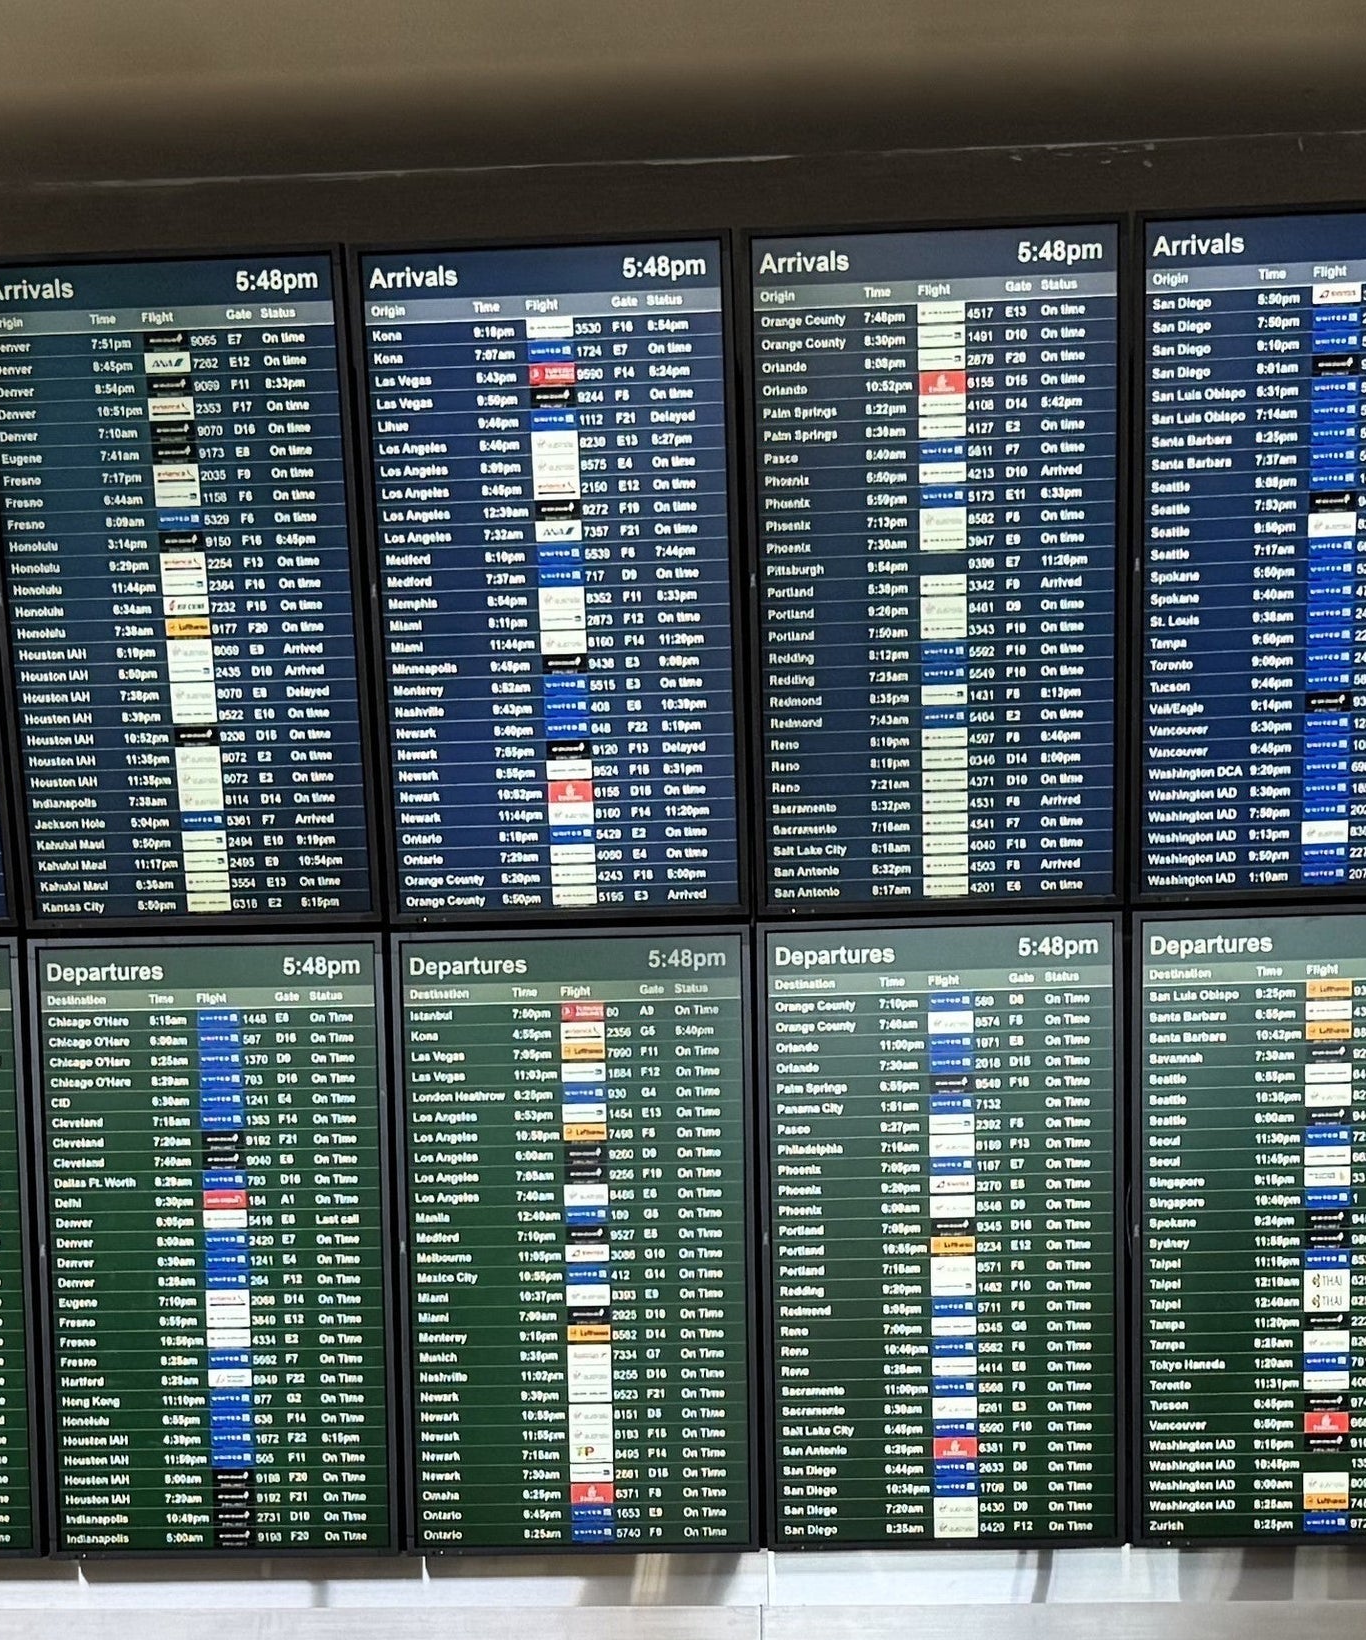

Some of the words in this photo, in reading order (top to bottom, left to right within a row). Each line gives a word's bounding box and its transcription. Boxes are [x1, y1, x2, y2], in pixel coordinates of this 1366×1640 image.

[1017, 239, 1103, 265] 5:48pm
[1152, 232, 1245, 257] Arrivals
[622, 255, 706, 281] 5:48pm
[759, 249, 850, 274] Arrivals
[236, 268, 318, 294] 5:48pm
[369, 264, 458, 289] Arrivals
[1151, 270, 1190, 289] Origin
[1257, 268, 1287, 281] Time
[1313, 264, 1347, 279] Flight
[759, 290, 796, 304] Origin
[863, 286, 892, 299] Time
[917, 283, 951, 298] Flight
[1004, 280, 1033, 292] Gate
[1040, 278, 1078, 291] Status
[88, 313, 117, 325] Time
[141, 311, 174, 326] Flight
[225, 308, 253, 320] Gate
[260, 307, 296, 319] Status
[370, 304, 406, 319] Origin
[472, 301, 501, 313] Time
[525, 298, 558, 313] Flight
[611, 295, 639, 308] Gate
[646, 294, 683, 306] Status
[775, 945, 895, 970] Departures
[1018, 935, 1099, 959] 5:48pm
[1150, 934, 1273, 959] Departures
[283, 956, 361, 979] 5:48pm
[409, 956, 528, 980] Departures
[648, 948, 726, 972] 5:48pm
[1148, 968, 1212, 981] Destination
[1255, 965, 1283, 978] Time
[1306, 962, 1339, 977] Flight
[46, 962, 164, 986] Departures
[774, 978, 836, 991] Destination
[878, 976, 906, 988] Time
[927, 973, 960, 988] Flight
[1008, 972, 1035, 984] Gate
[1044, 971, 1080, 983] Status
[46, 994, 107, 1006] Destination
[148, 993, 175, 1004] Time
[195, 992, 227, 1005] Flight
[274, 991, 300, 1002] Gate
[308, 990, 343, 1002] Status
[409, 988, 470, 1000] Destination
[511, 986, 538, 998] Time
[560, 985, 591, 999] Flight
[639, 983, 665, 995] Gate
[674, 983, 709, 994] Status
[328, 1011, 354, 1023] Time
